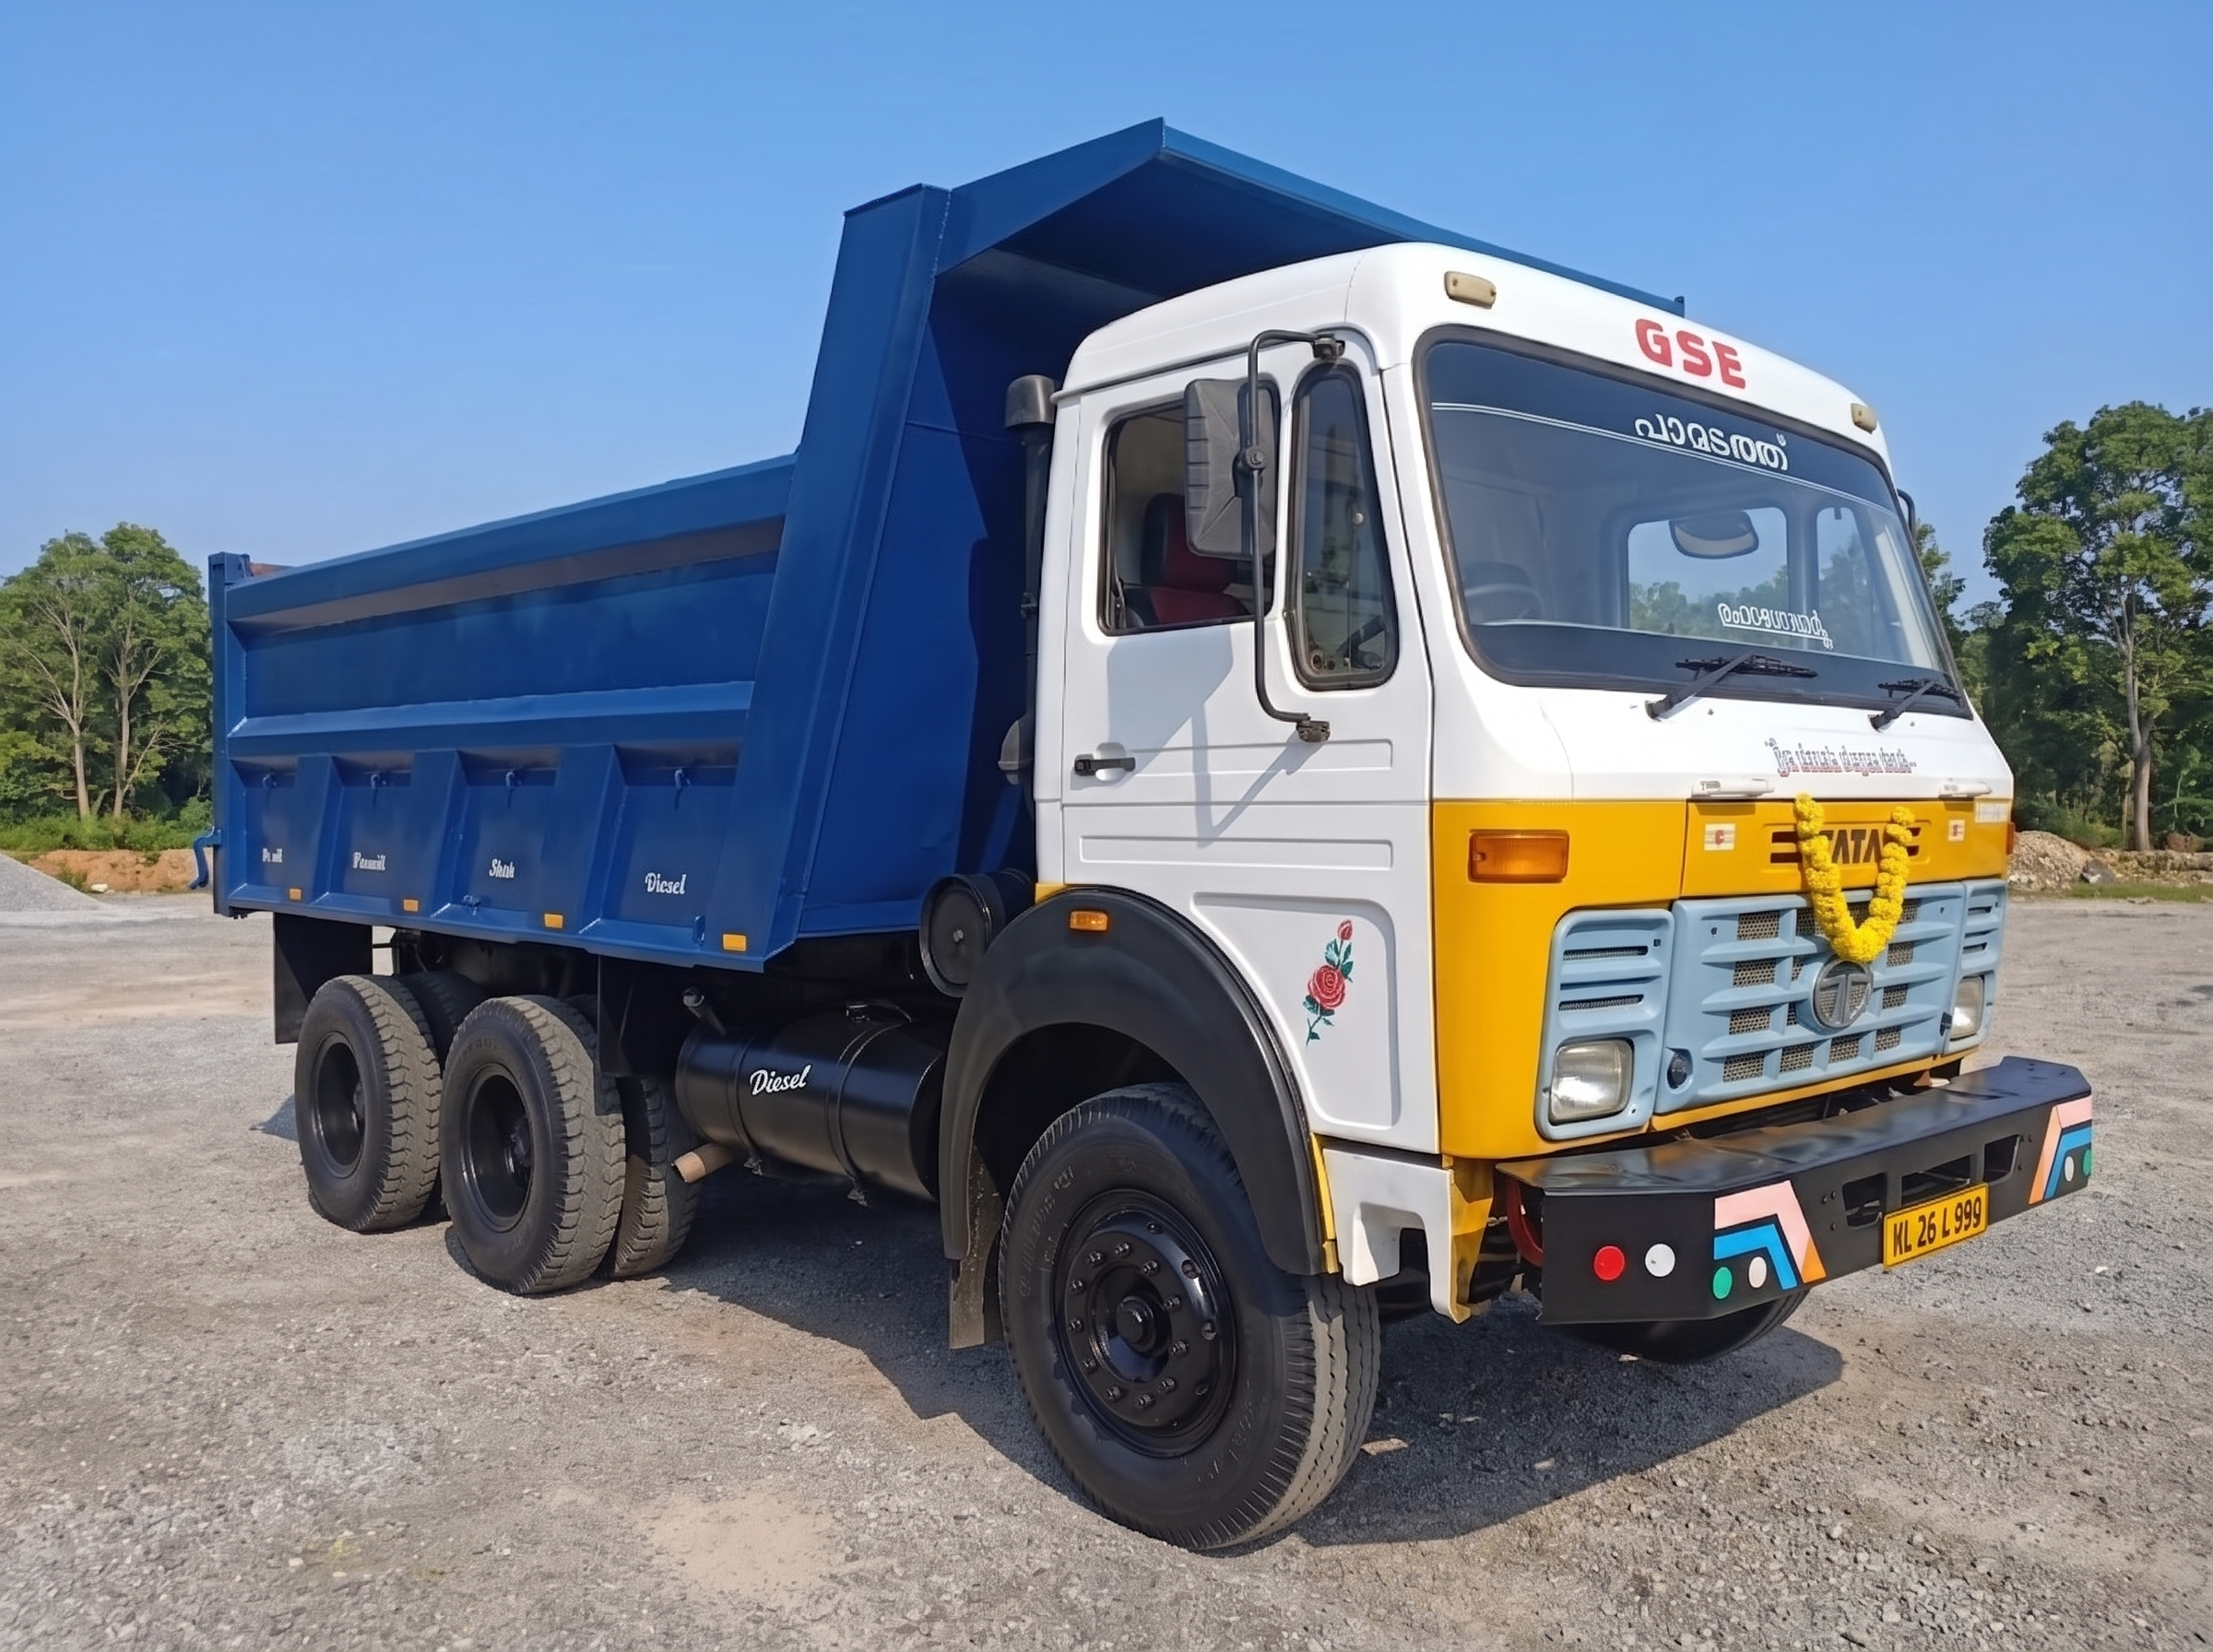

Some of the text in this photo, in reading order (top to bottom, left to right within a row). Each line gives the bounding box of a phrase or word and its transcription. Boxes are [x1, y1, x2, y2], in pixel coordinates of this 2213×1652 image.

[1635, 318, 1746, 389] GSE
[1818, 828, 1882, 864] ATA
[750, 1064, 811, 1096] Diesel
[1893, 1196, 1982, 1257] KL 26 L 999
